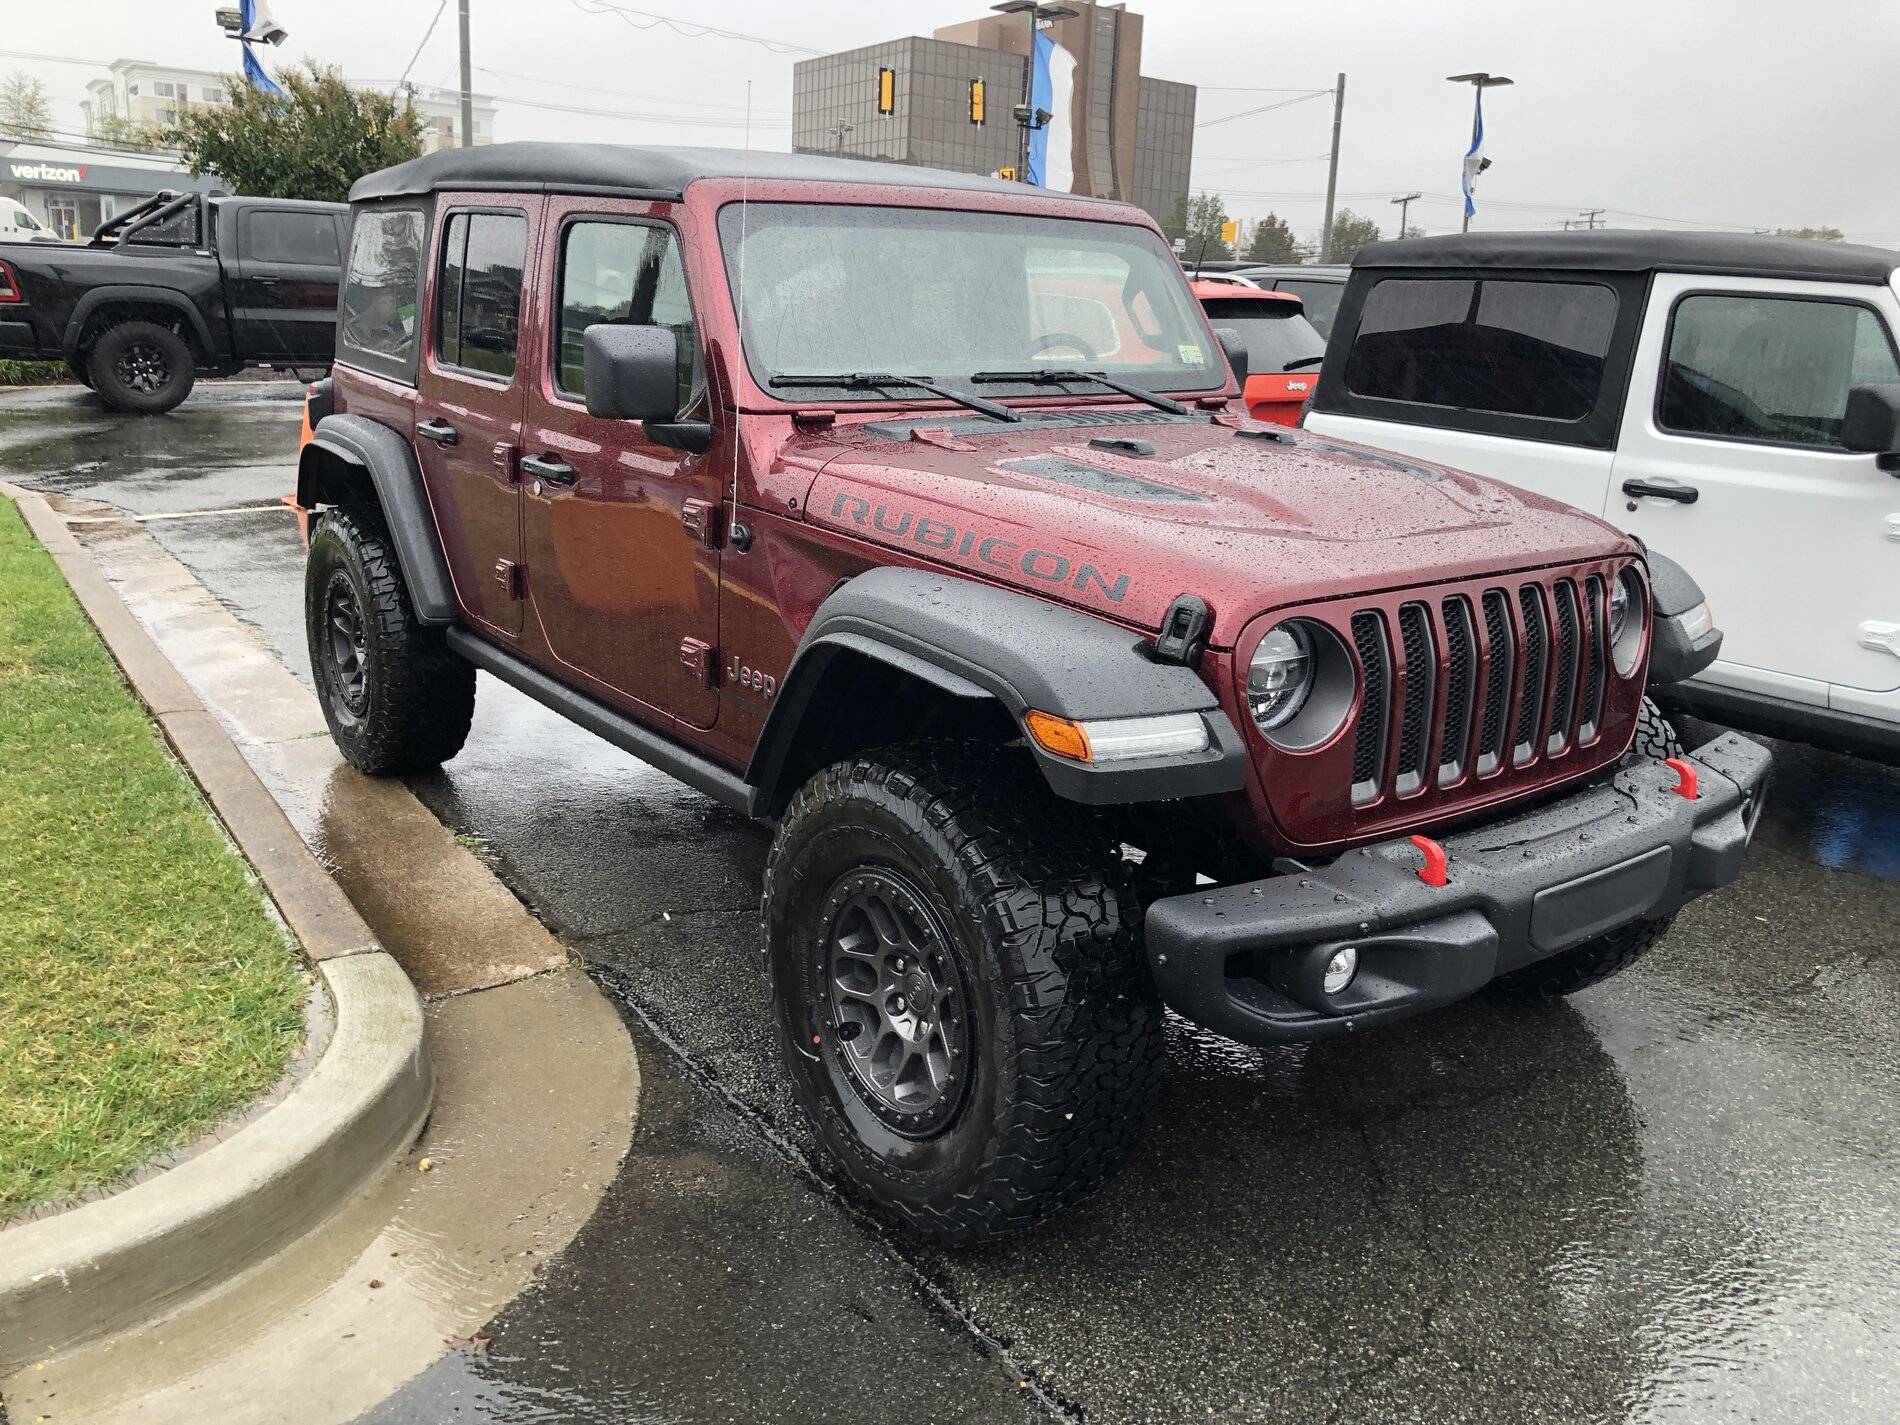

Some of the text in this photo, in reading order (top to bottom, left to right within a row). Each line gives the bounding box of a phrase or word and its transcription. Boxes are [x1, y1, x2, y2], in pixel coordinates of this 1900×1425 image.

[10, 163, 80, 182] verizon
[1287, 380, 1307, 391] Jeep
[830, 493, 1132, 602] RUBICON
[726, 655, 776, 699] Jeep
